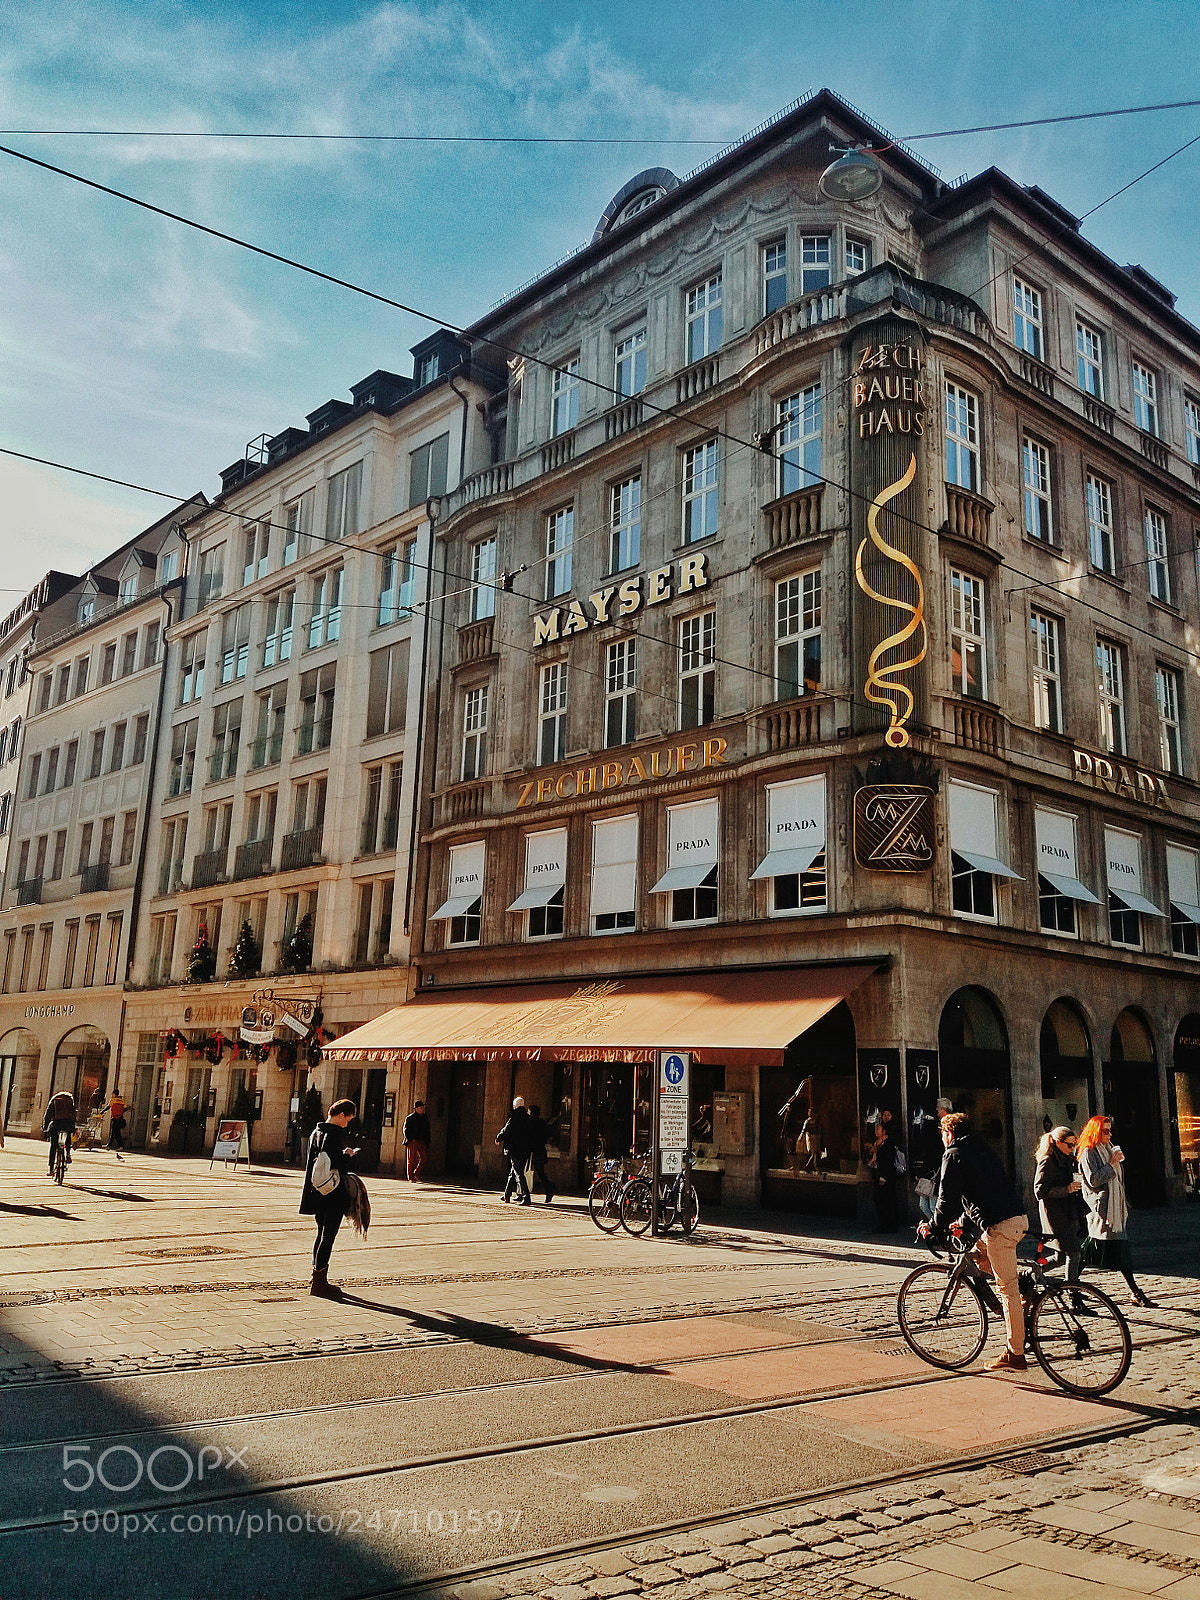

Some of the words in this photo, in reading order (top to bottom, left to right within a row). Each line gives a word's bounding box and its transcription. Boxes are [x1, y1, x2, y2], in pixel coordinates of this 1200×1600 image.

[858, 343, 921, 371] ZECH
[854, 375, 929, 410] BAUER
[860, 408, 924, 438] HAUS
[533, 552, 709, 648] MAYSER
[516, 737, 729, 809] ZECHBAUER
[1072, 749, 1172, 813] PRADA
[776, 819, 818, 834] PRADA
[676, 838, 711, 851] PRADA
[1041, 844, 1070, 860] PRADA
[532, 862, 560, 873] PRADA
[1109, 861, 1136, 875] PRADA
[455, 873, 479, 884] PRADA
[25, 1004, 75, 1018] LONGCHAMP
[666, 1085, 682, 1094] ZONE
